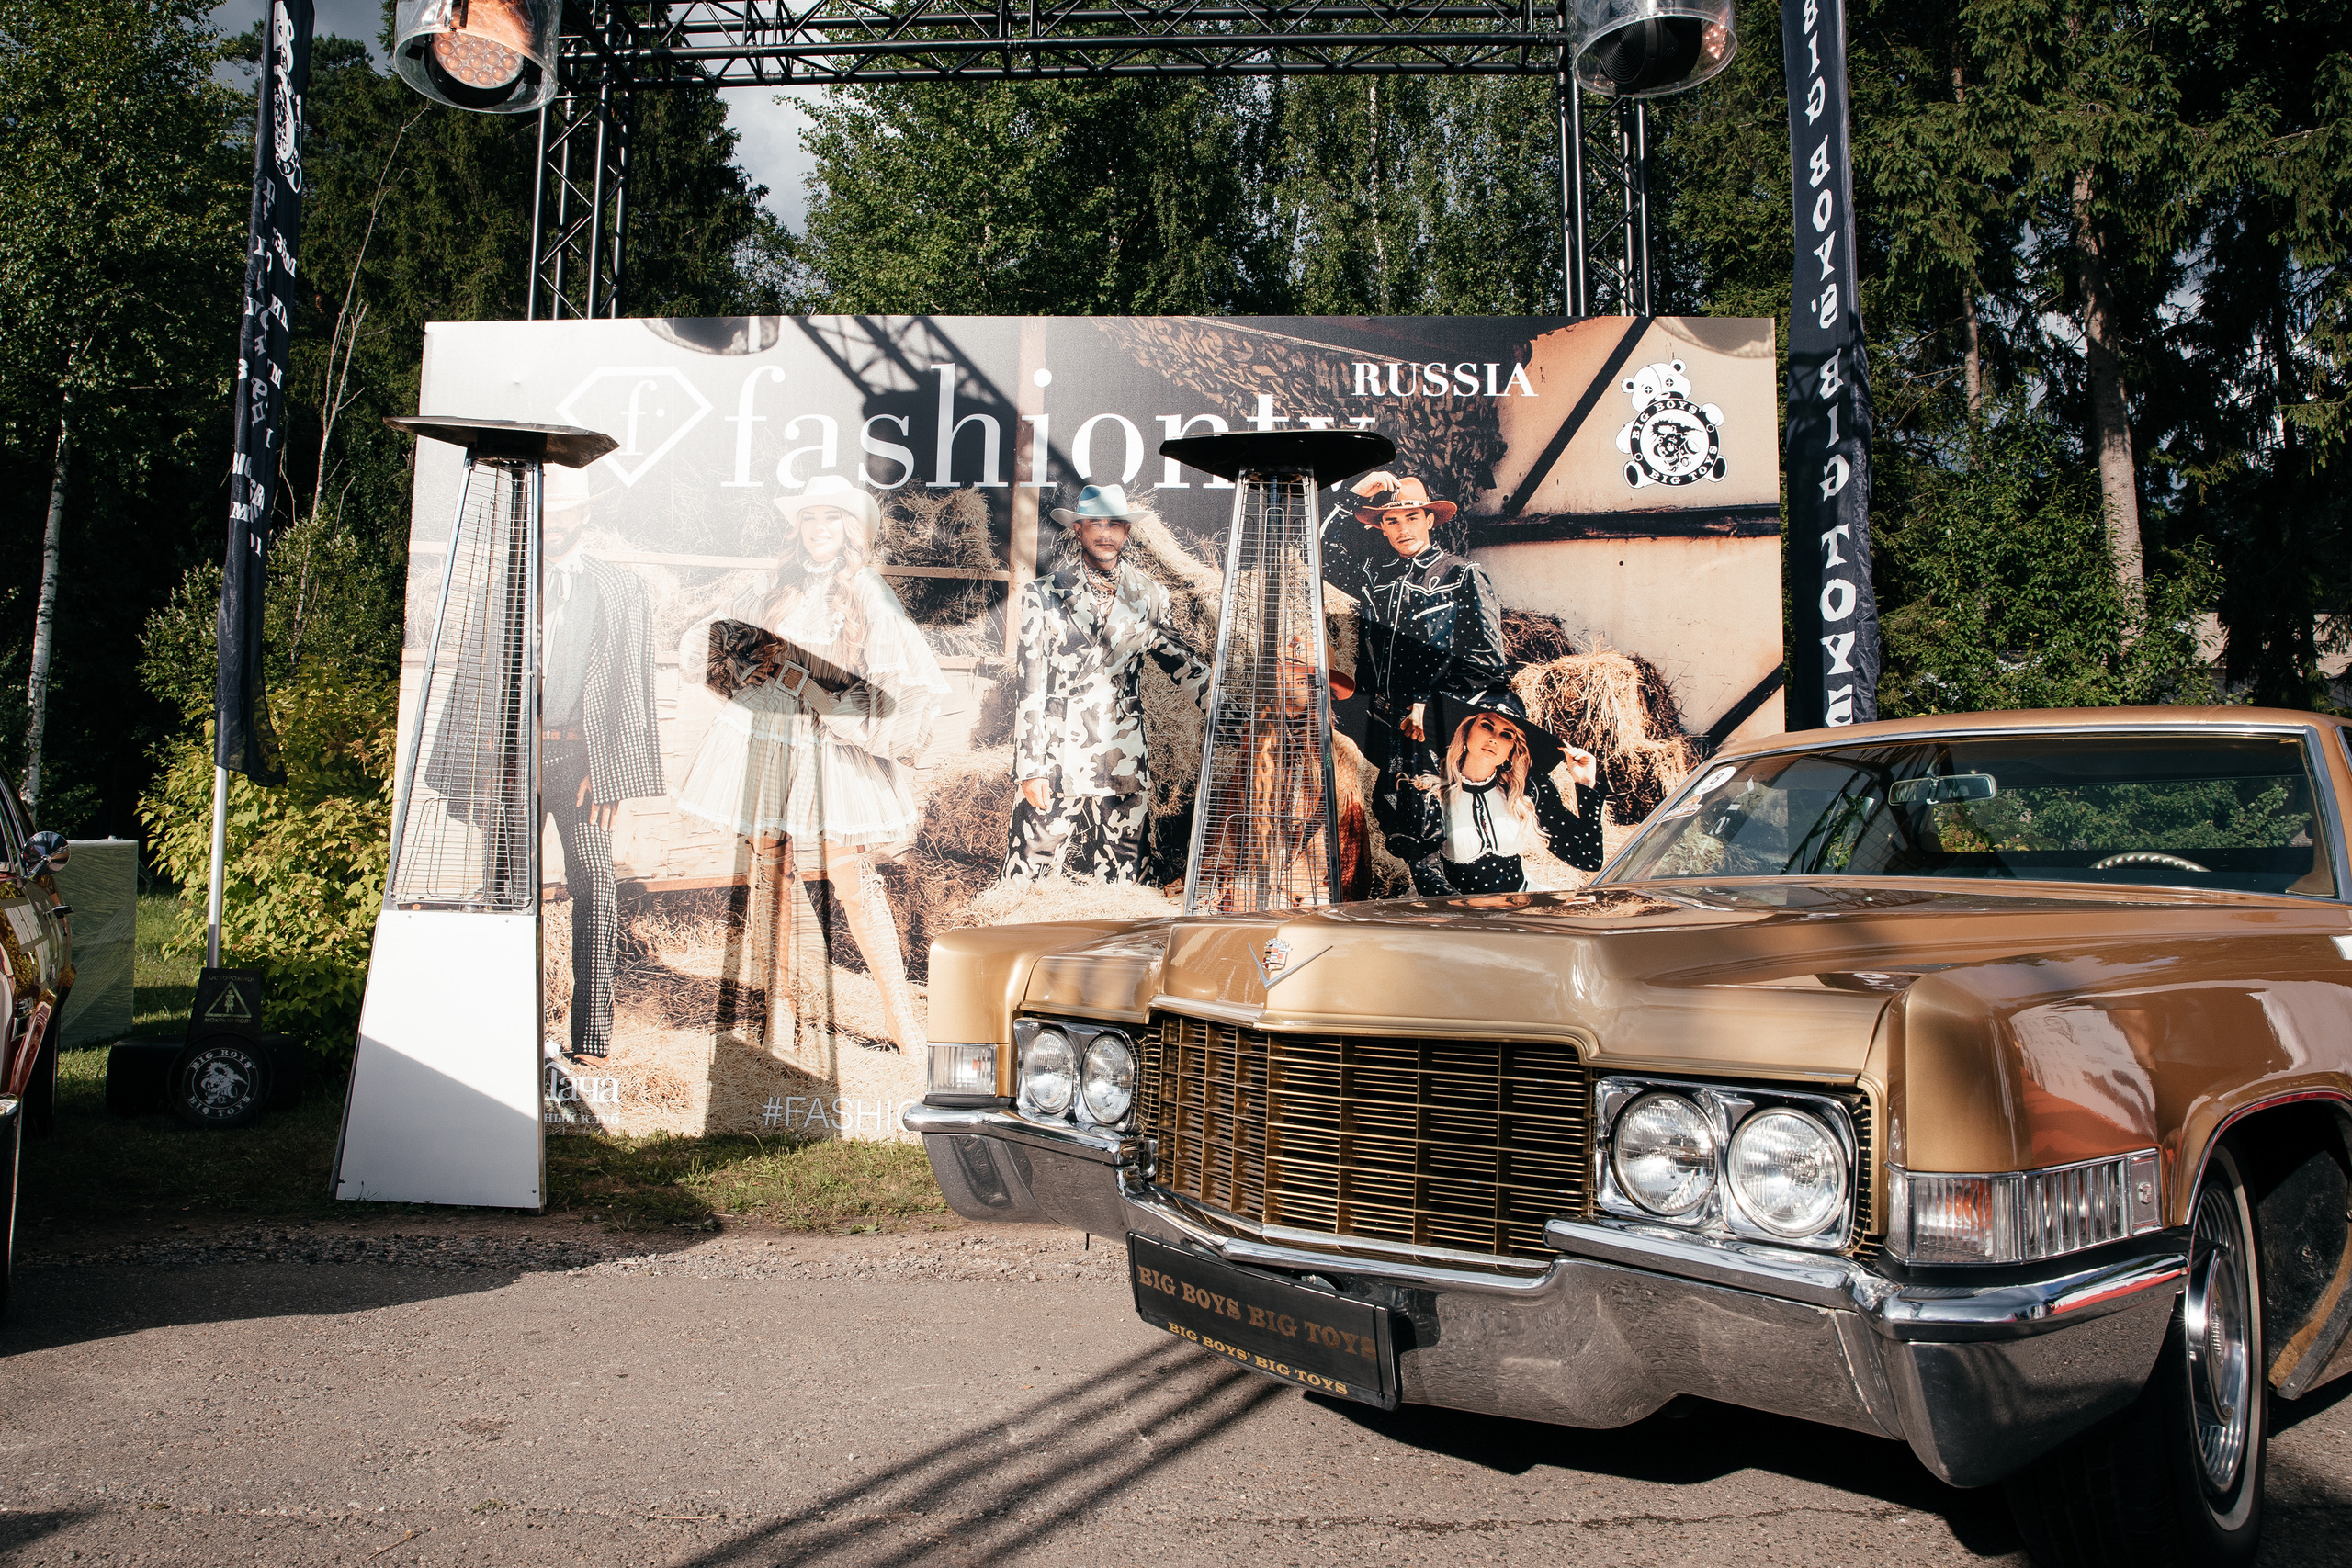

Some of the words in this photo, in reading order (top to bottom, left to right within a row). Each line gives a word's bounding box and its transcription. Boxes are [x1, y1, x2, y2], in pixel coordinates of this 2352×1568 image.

[1351, 362, 1539, 398] RUSSIA
[1631, 412, 1650, 440] BIG
[1653, 400, 1702, 413] BOYS'
[1648, 468, 1681, 485] BIG
[1688, 445, 1718, 482] TOYS
[191, 1051, 213, 1070] BIG
[217, 1095, 251, 1118] TOYS
[581, 1112, 620, 1127] клуб
[1137, 1264, 1176, 1296] BIG
[1181, 1280, 1241, 1321] BOYS
[1247, 1303, 1298, 1338] BIG
[1304, 1320, 1377, 1361] TOYS
[1168, 1321, 1199, 1342] BIG
[1202, 1335, 1250, 1361] BOYS'
[1255, 1355, 1291, 1377] BIG
[1295, 1369, 1349, 1395] TOYS
